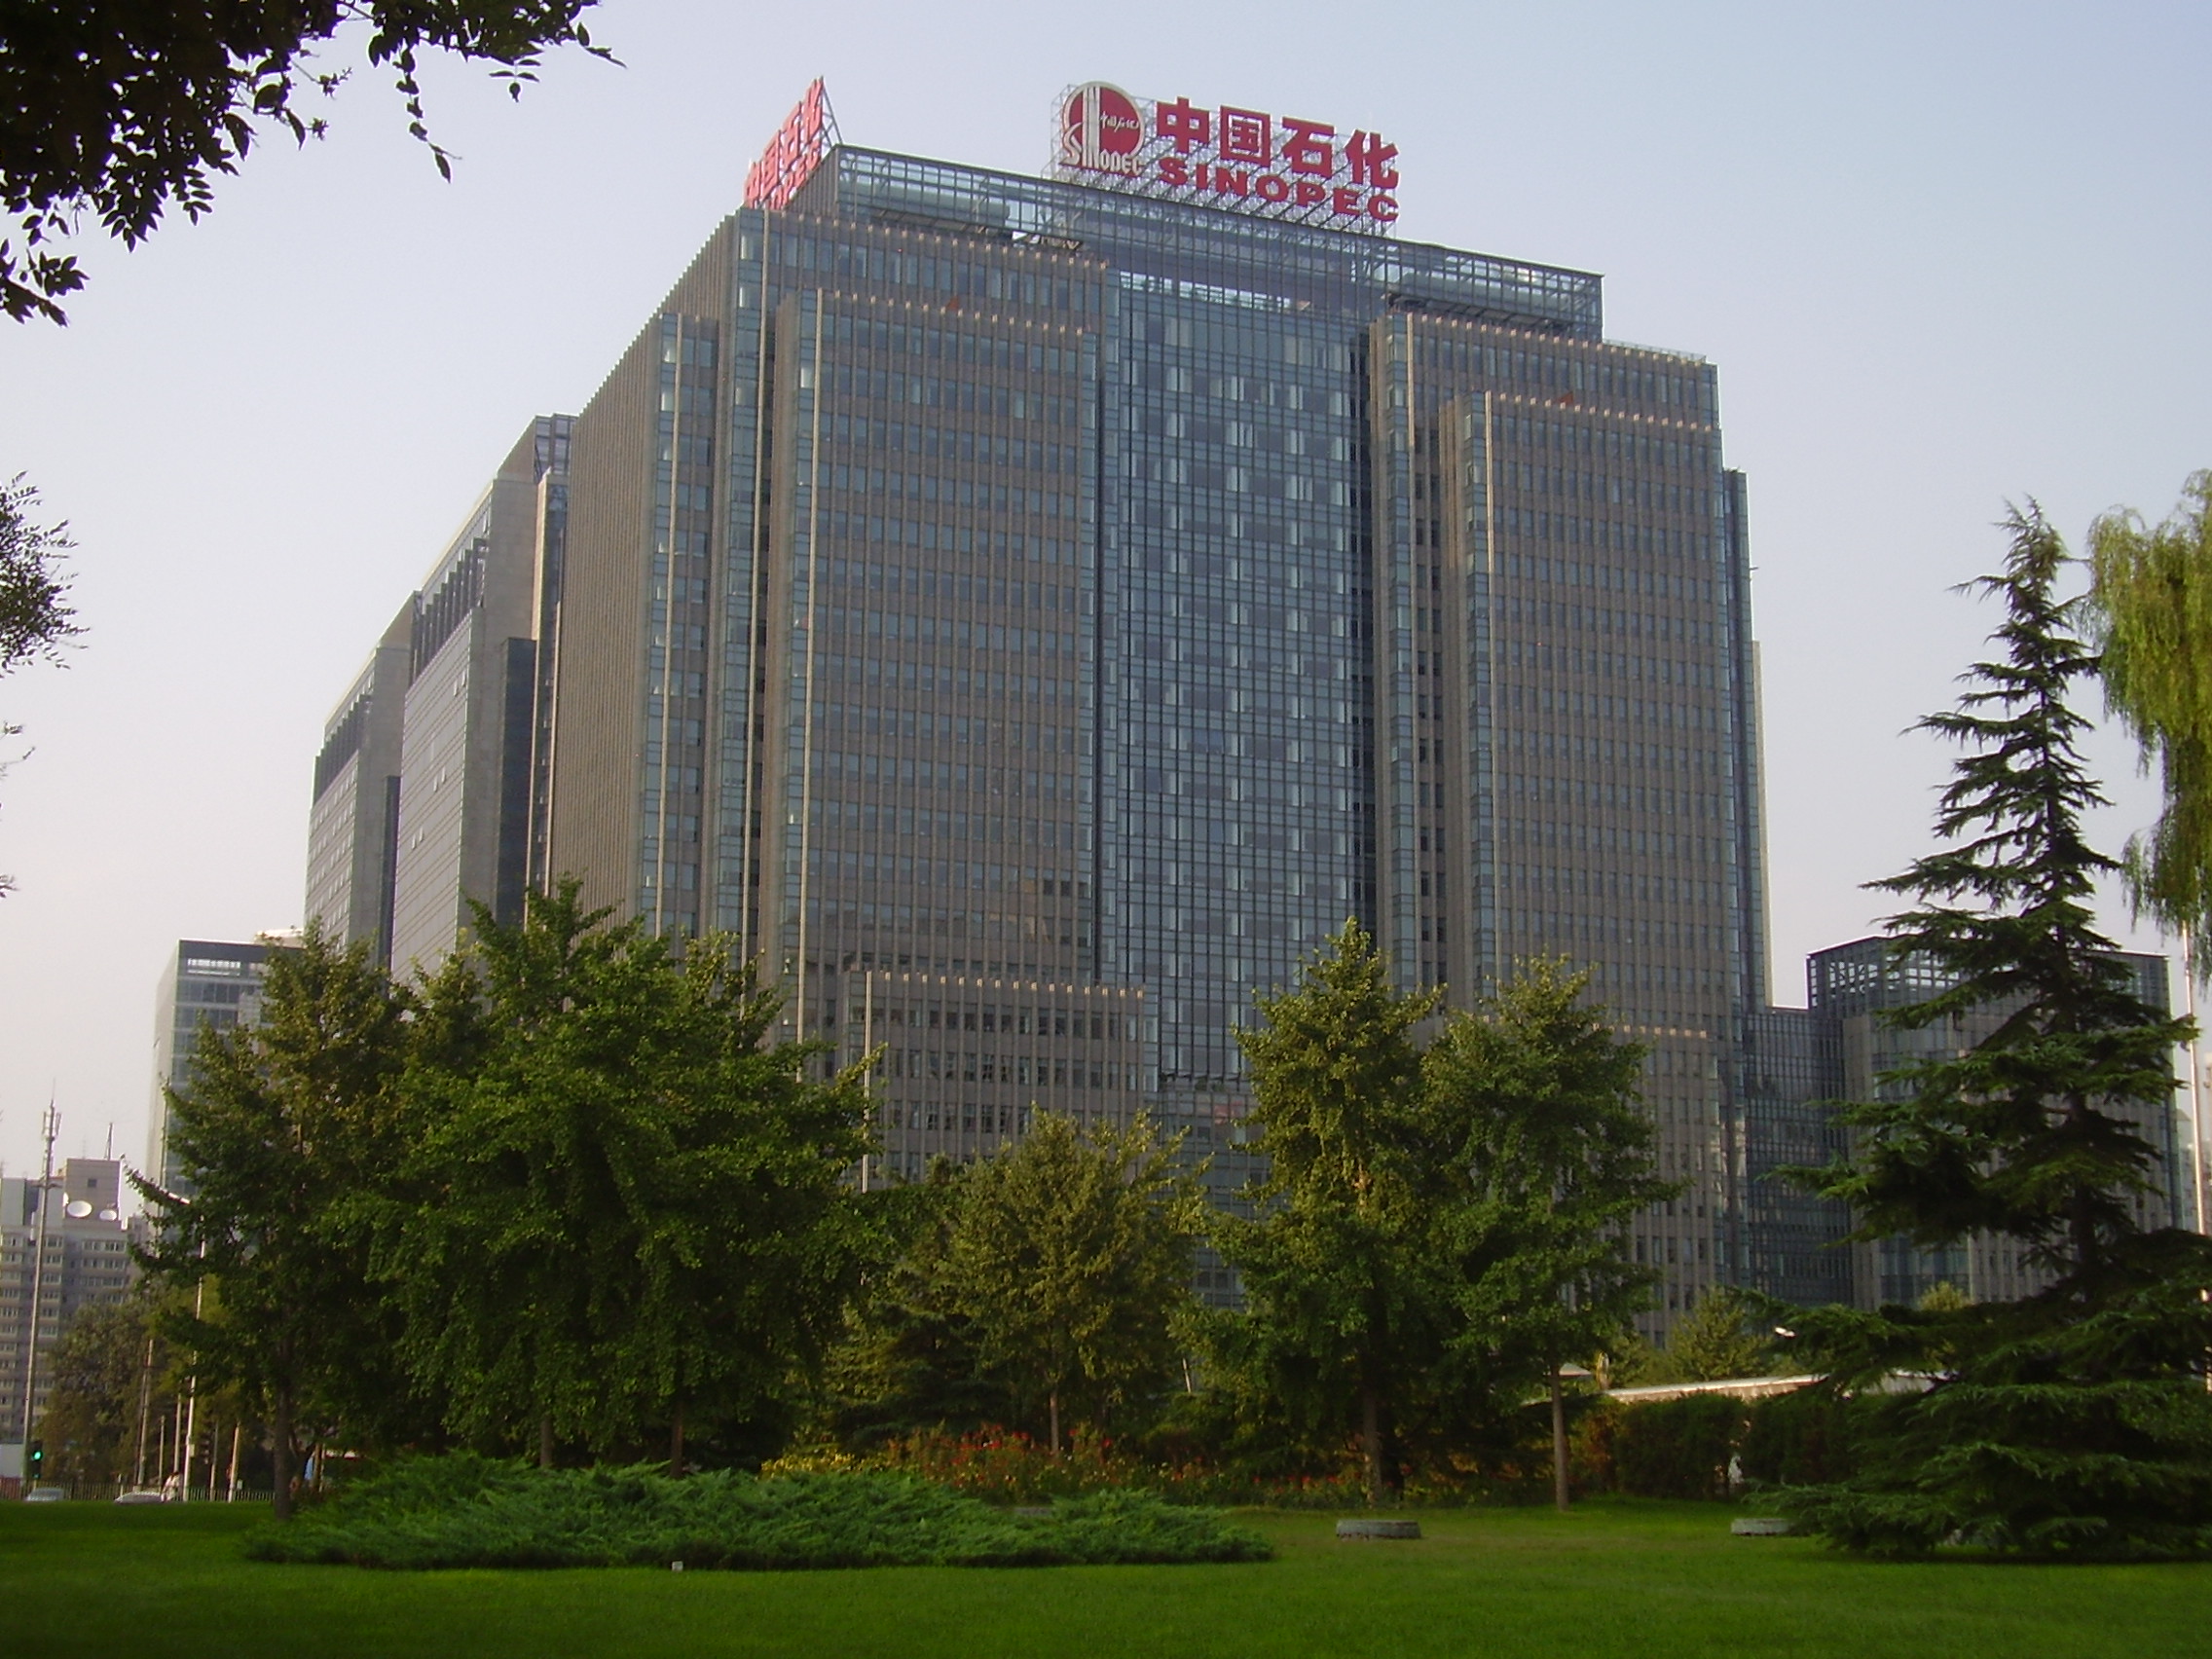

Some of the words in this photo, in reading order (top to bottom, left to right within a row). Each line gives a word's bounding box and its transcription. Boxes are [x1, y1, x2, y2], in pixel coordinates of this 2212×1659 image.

[1157, 96, 1399, 189] 中国石化
[1159, 158, 1399, 221] SINOPEC
